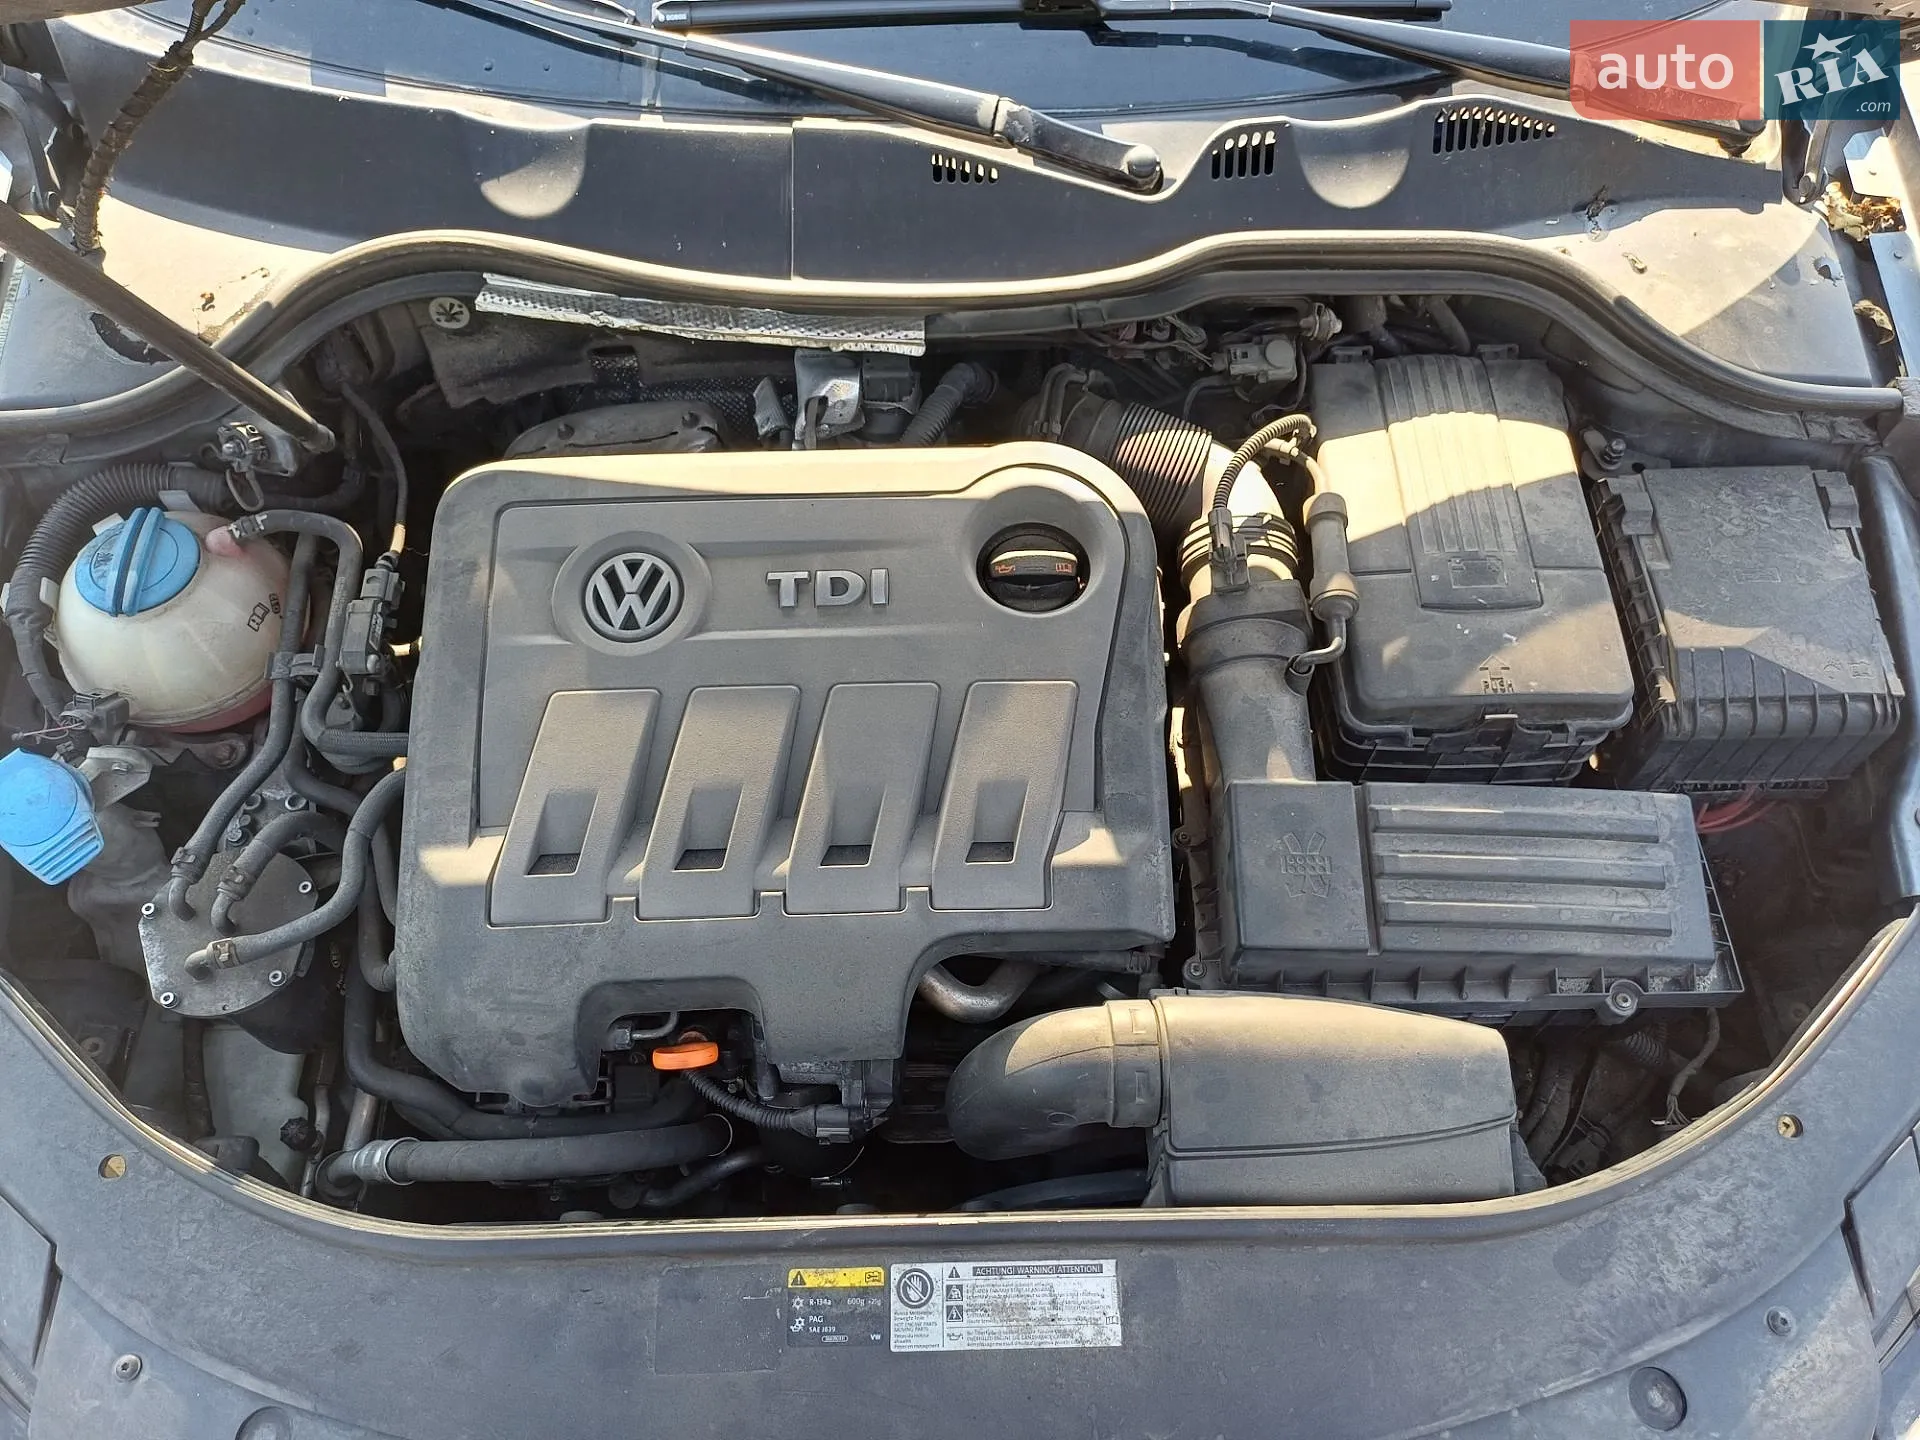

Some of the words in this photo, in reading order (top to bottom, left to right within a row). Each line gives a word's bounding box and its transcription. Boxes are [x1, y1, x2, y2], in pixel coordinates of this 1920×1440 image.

[766, 567, 890, 609] TDI
[1481, 679, 1515, 694] PUSH
[975, 1267, 1015, 1276] ACHTUNG!
[1016, 1265, 1056, 1274] WARNING!
[1057, 1264, 1101, 1273] ATTENTION!
[809, 1298, 832, 1306] R-134a
[847, 1297, 865, 1307] 600g
[808, 1315, 824, 1323] PAG
